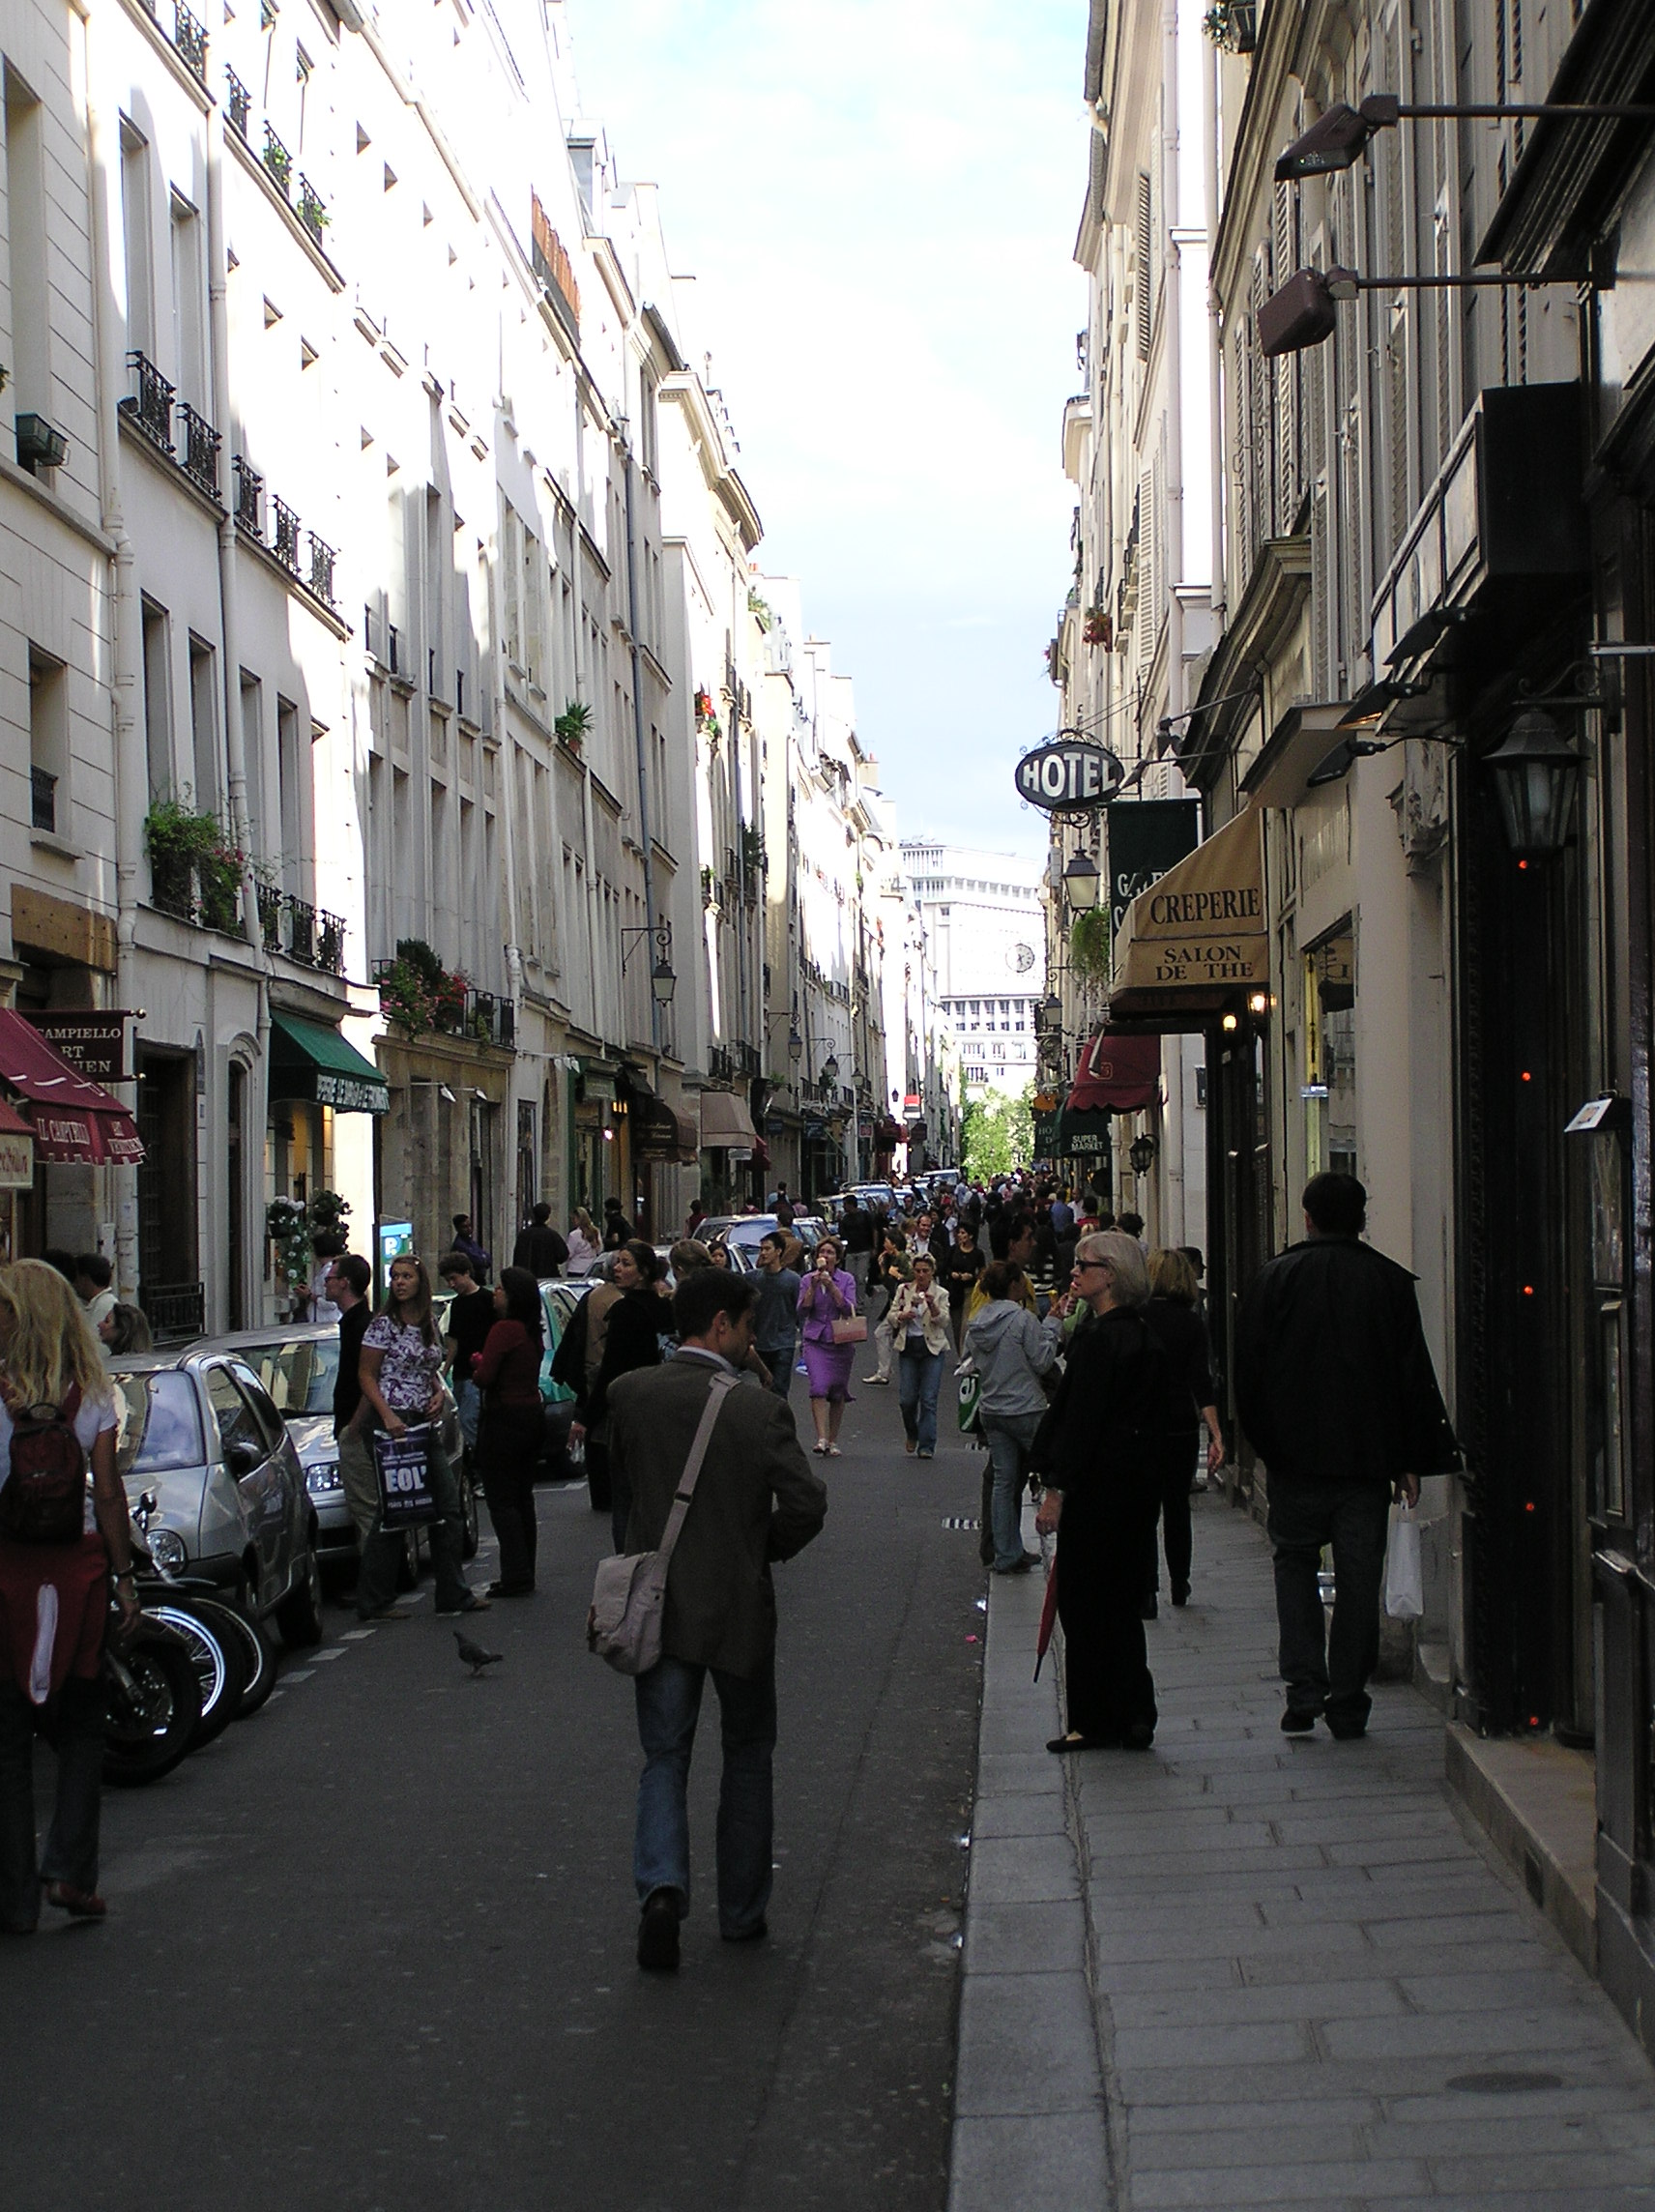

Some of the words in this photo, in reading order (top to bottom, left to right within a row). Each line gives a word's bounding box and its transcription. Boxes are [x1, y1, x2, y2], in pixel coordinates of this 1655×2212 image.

[1023, 752, 1117, 799] HOTEL
[1150, 888, 1261, 925] CREPERIE
[1164, 945, 1241, 965] SALON
[1156, 966, 1188, 981] DE
[1204, 962, 1254, 978] THE
[1071, 1141, 1103, 1151] MARKET
[1072, 1134, 1098, 1144] SUPER
